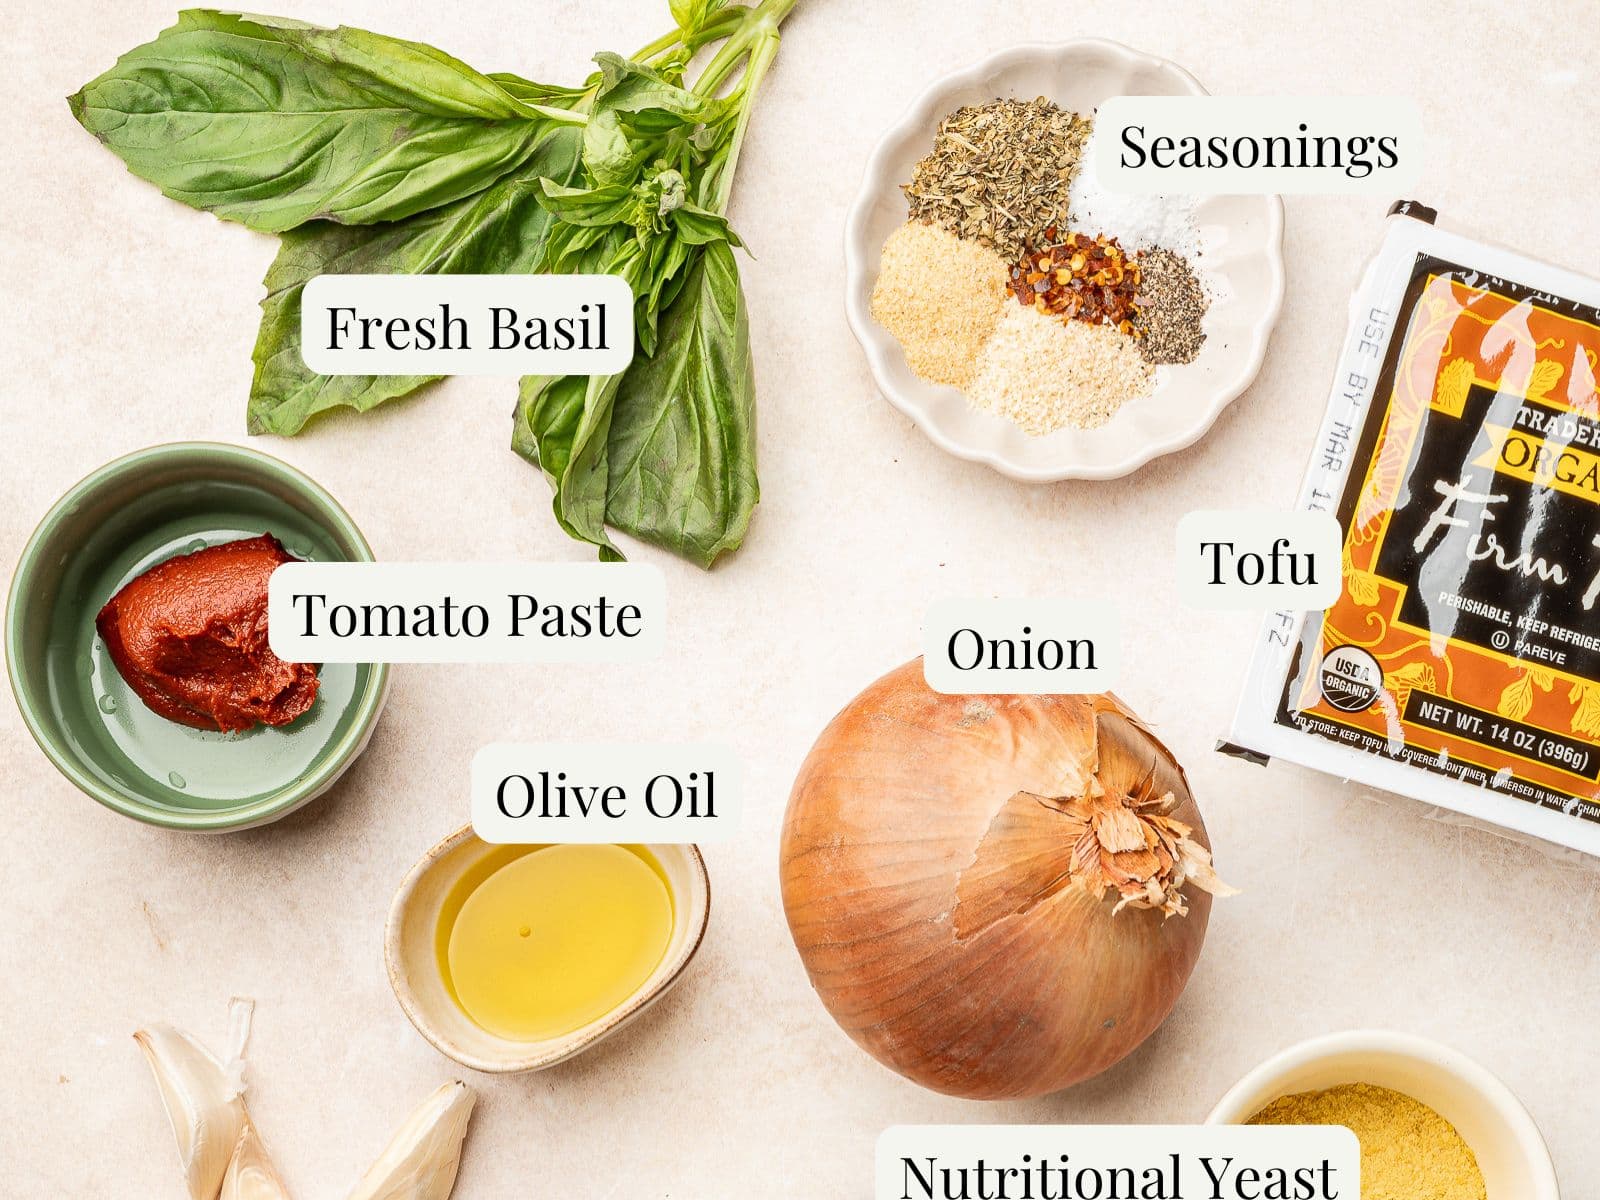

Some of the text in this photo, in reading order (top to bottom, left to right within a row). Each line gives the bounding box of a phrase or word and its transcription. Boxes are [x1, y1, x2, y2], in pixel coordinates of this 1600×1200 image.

[1359, 308, 1389, 358] USE
[1343, 373, 1368, 406] BY
[1321, 421, 1353, 472] MAR
[1307, 488, 1331, 511] 1
[1438, 591, 1513, 627] PERISHABLE,
[1516, 615, 1549, 635] KEEP
[1514, 640, 1567, 665] PAREVE
[1325, 675, 1370, 700] ORGANIC
[1308, 720, 1338, 736] STORE:
[1339, 728, 1361, 743] KEEP
[1361, 735, 1383, 750] TOFU
[1419, 701, 1589, 771] NET WT. 14 OZ (396g)
